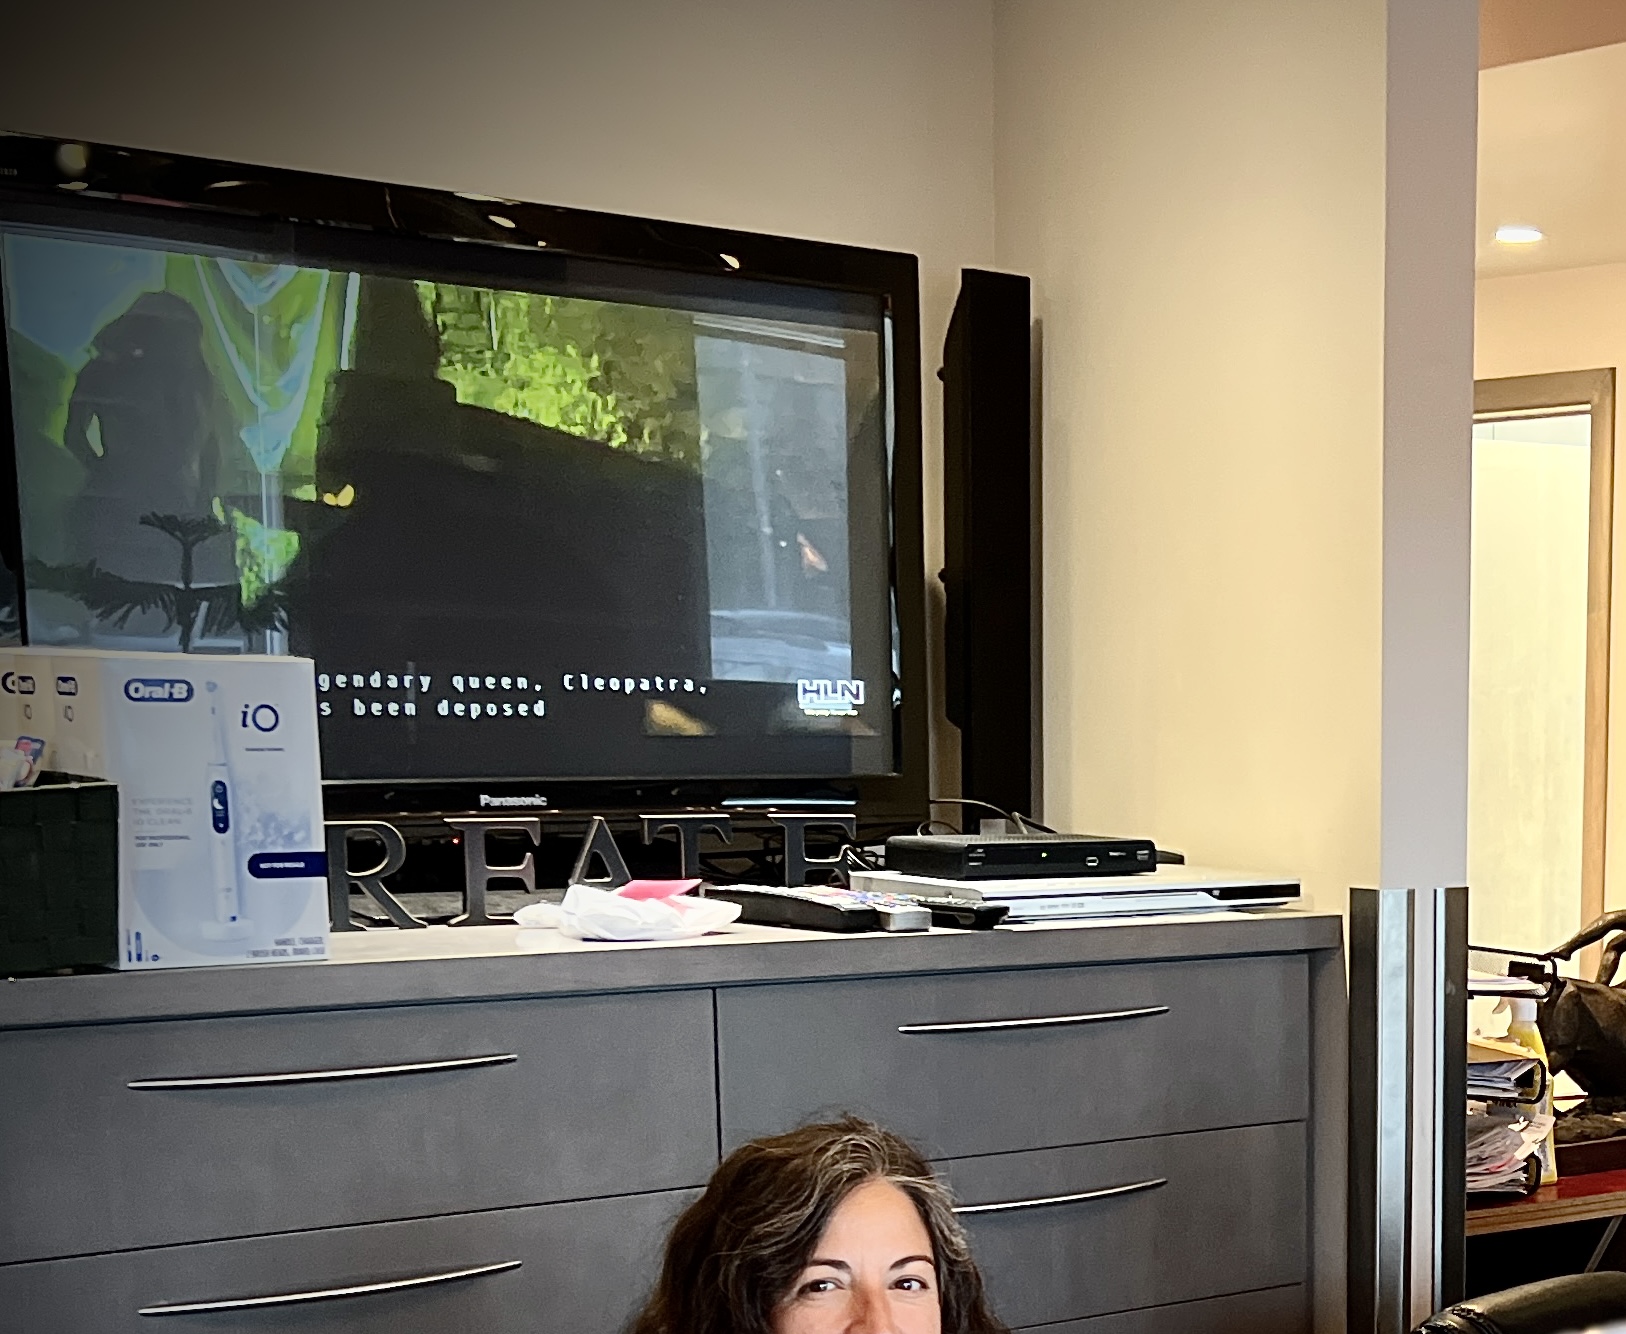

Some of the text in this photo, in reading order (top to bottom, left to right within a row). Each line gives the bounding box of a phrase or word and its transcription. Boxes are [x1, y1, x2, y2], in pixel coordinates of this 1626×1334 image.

[128, 682, 189, 699] Oral-B
[318, 671, 431, 692] gendary
[241, 704, 279, 732] iO
[319, 698, 545, 719] s been deposed
[479, 794, 547, 807] Panasonic
